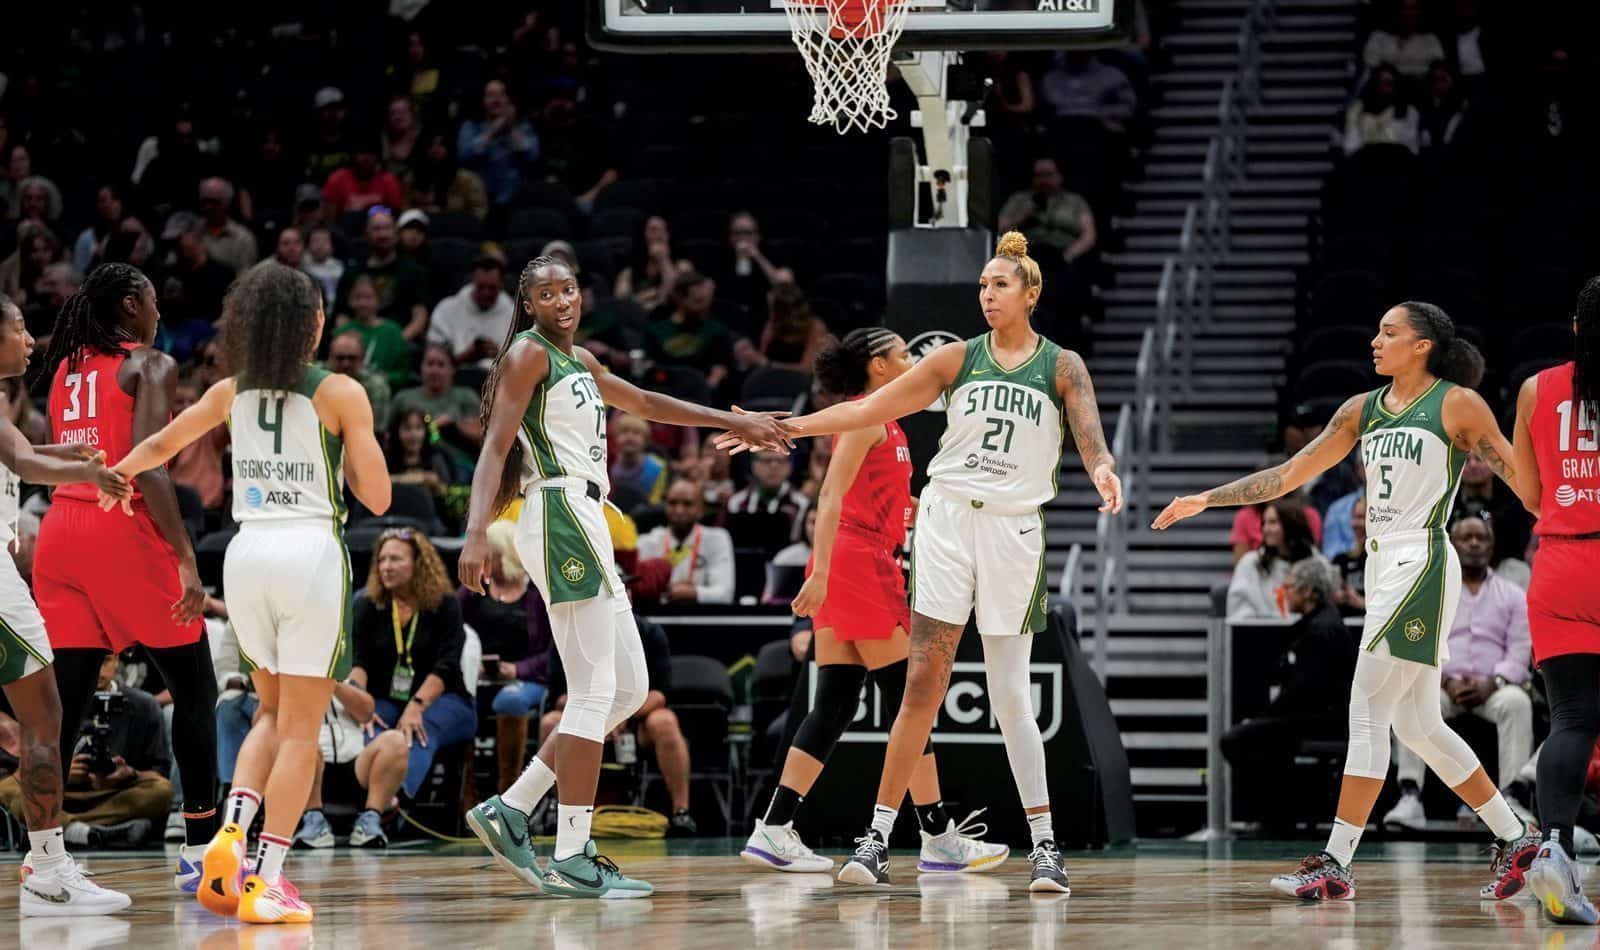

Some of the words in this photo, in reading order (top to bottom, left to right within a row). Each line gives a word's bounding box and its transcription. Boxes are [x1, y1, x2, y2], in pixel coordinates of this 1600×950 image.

[63, 370, 99, 421] 31
[964, 384, 1042, 427] STORM
[60, 426, 99, 446] CHARLES
[258, 396, 285, 454] 4
[981, 417, 1015, 453] 21
[1556, 399, 1599, 451] 15
[1365, 431, 1423, 467] STORM
[1379, 465, 1393, 499] 5
[1562, 458, 1594, 479] GRAY
[265, 491, 302, 505] AT&T
